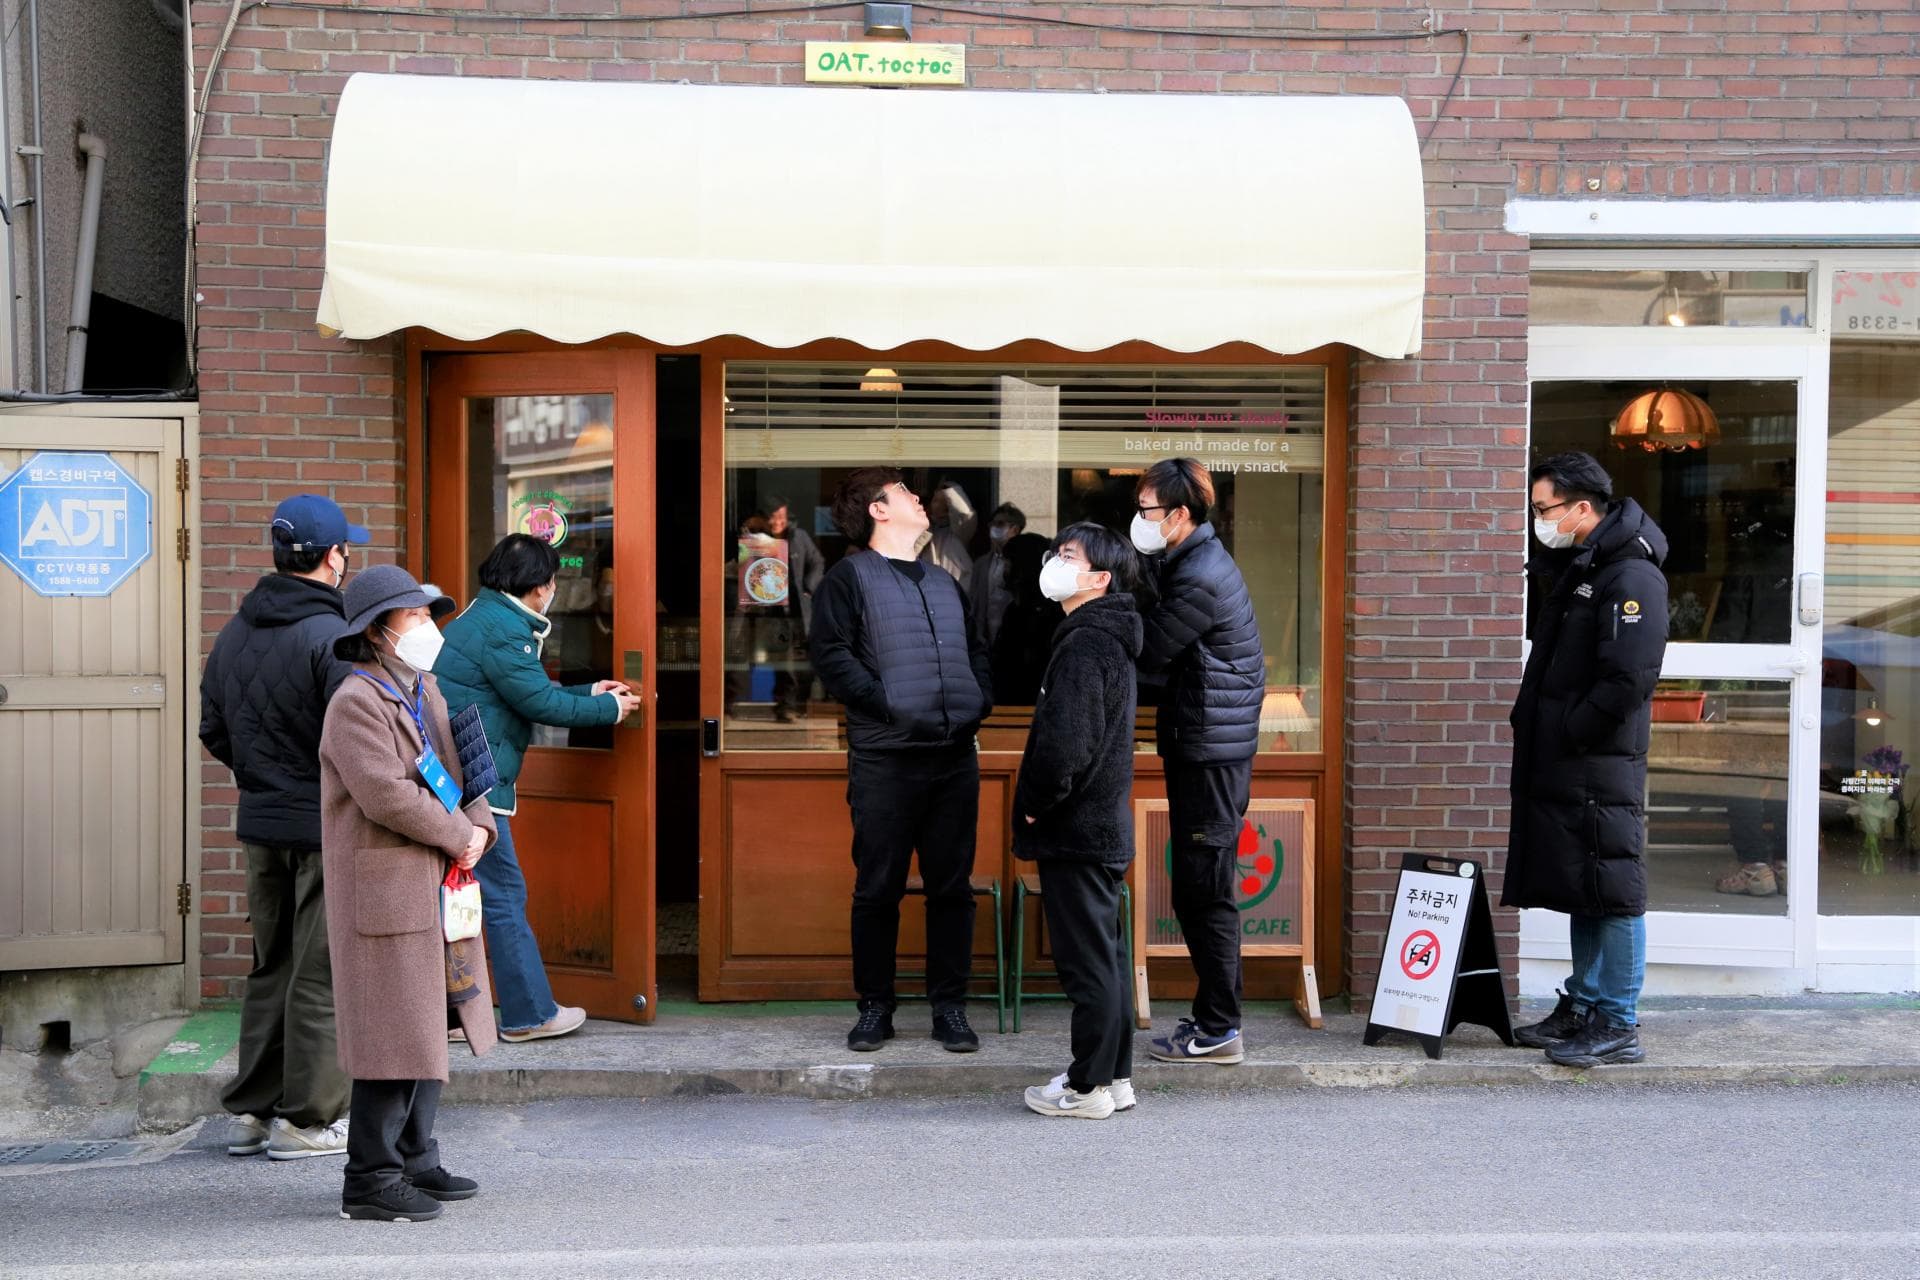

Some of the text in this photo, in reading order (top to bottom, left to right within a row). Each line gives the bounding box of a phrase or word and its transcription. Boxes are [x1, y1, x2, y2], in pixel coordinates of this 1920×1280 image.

[1145, 410, 1199, 428] Slowly
[1205, 411, 1233, 424] but
[1124, 437, 1290, 453] baked and made for a
[1243, 460, 1289, 473] snack
[21, 499, 126, 548] ADT
[1406, 888, 1458, 910] 주차금지
[1407, 909, 1450, 925] No! Parking
[1243, 917, 1292, 936] CAFE
